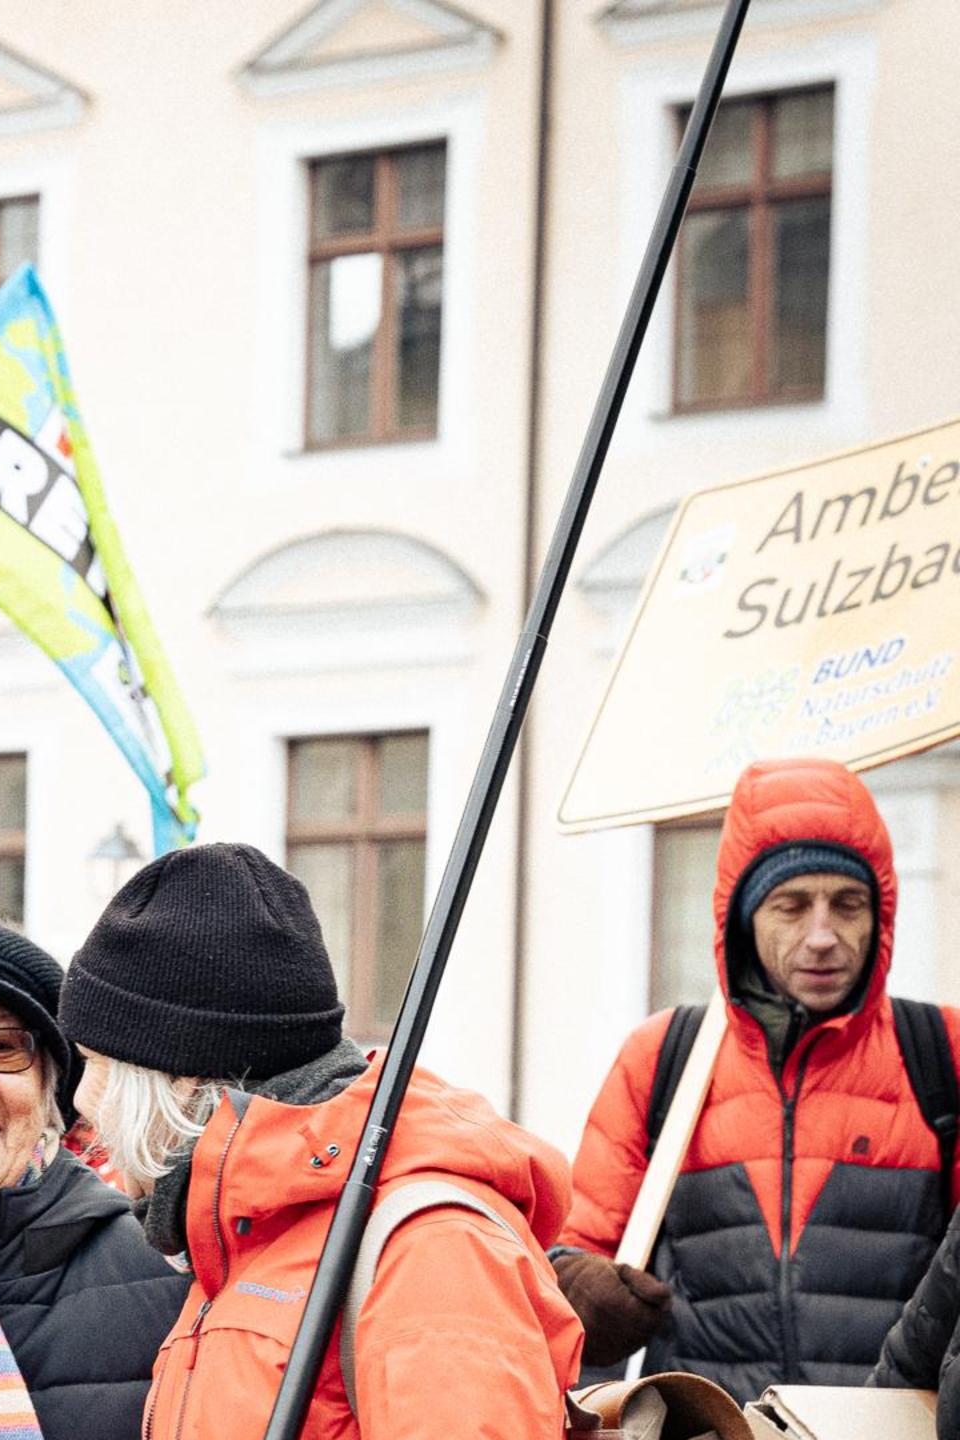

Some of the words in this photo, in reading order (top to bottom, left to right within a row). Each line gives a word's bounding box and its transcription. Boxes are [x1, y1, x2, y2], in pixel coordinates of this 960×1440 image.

[756, 459, 960, 553] Ambe
[723, 541, 960, 638] Sulzba
[813, 638, 904, 684] BUND
